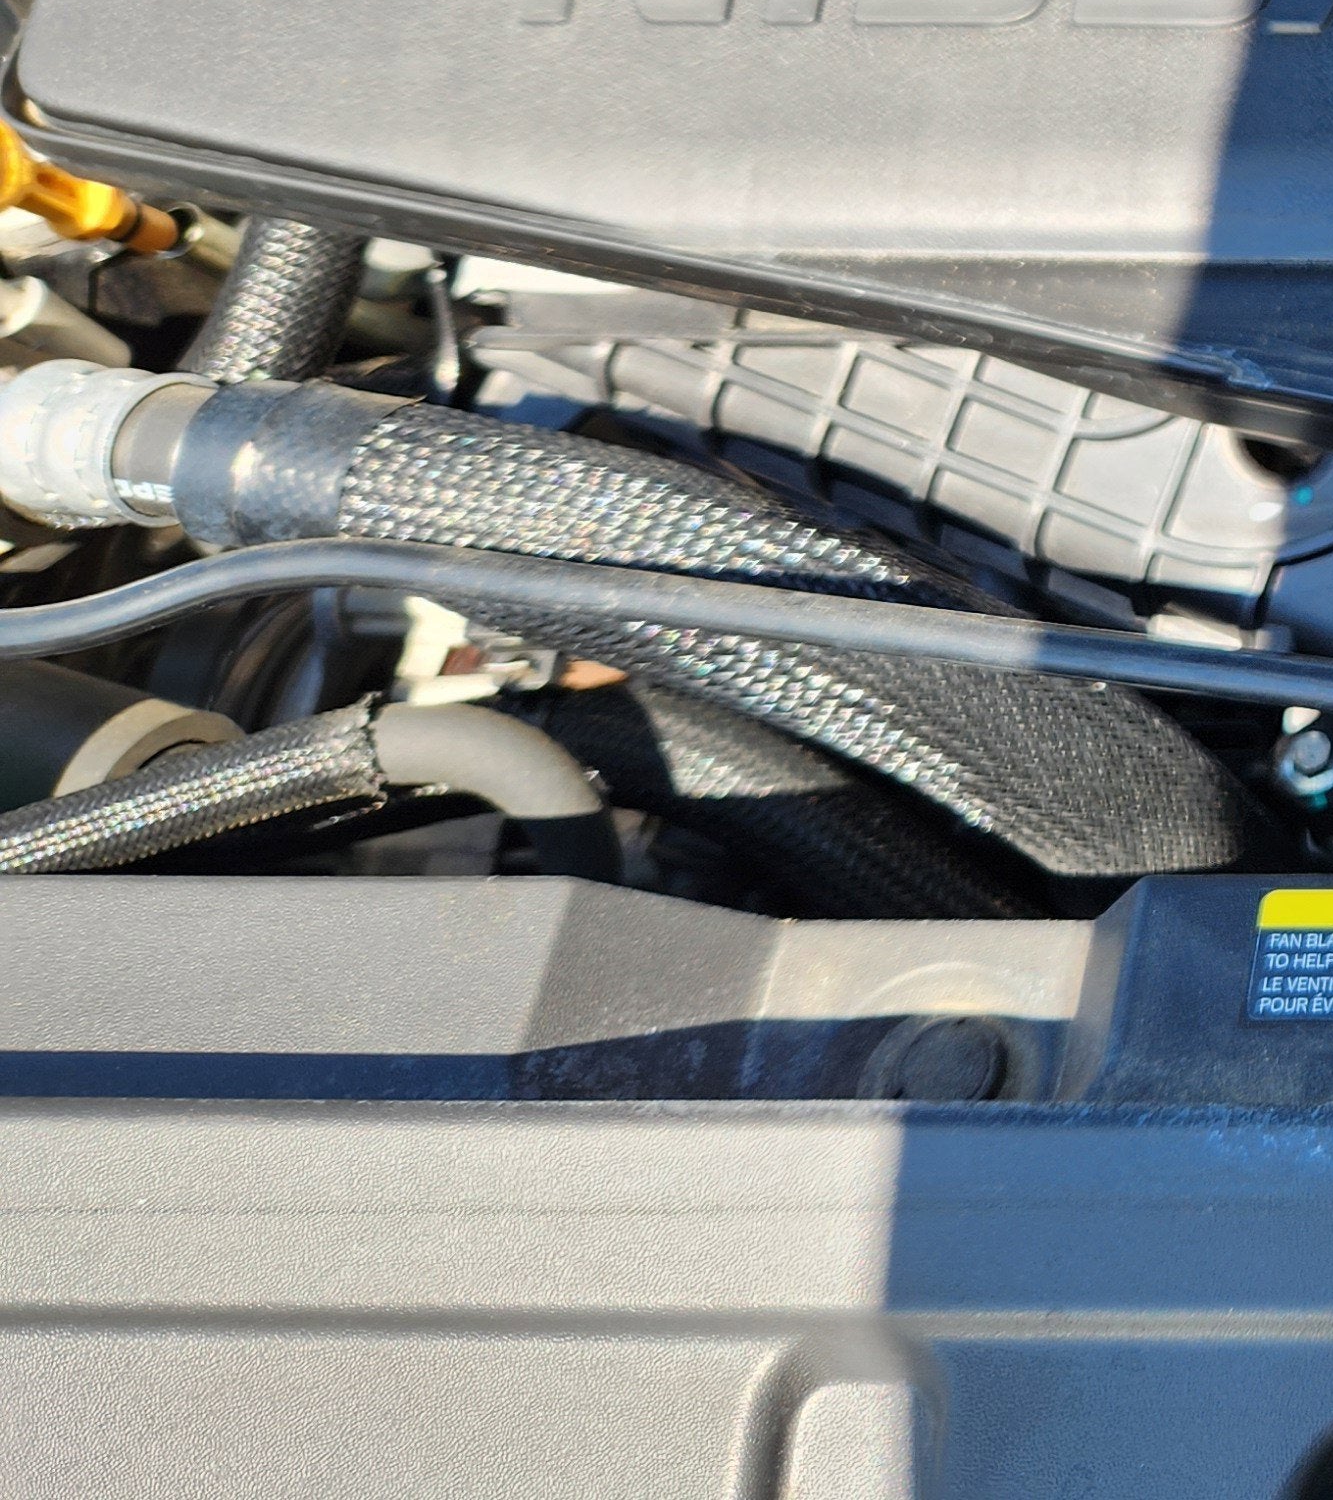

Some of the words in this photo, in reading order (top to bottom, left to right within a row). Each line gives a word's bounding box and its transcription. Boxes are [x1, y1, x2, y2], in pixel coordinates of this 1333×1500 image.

[1269, 933, 1302, 949] FAN
[1266, 953, 1290, 969] TO
[1263, 977, 1282, 992] LE
[1259, 998, 1308, 1013] POUR
